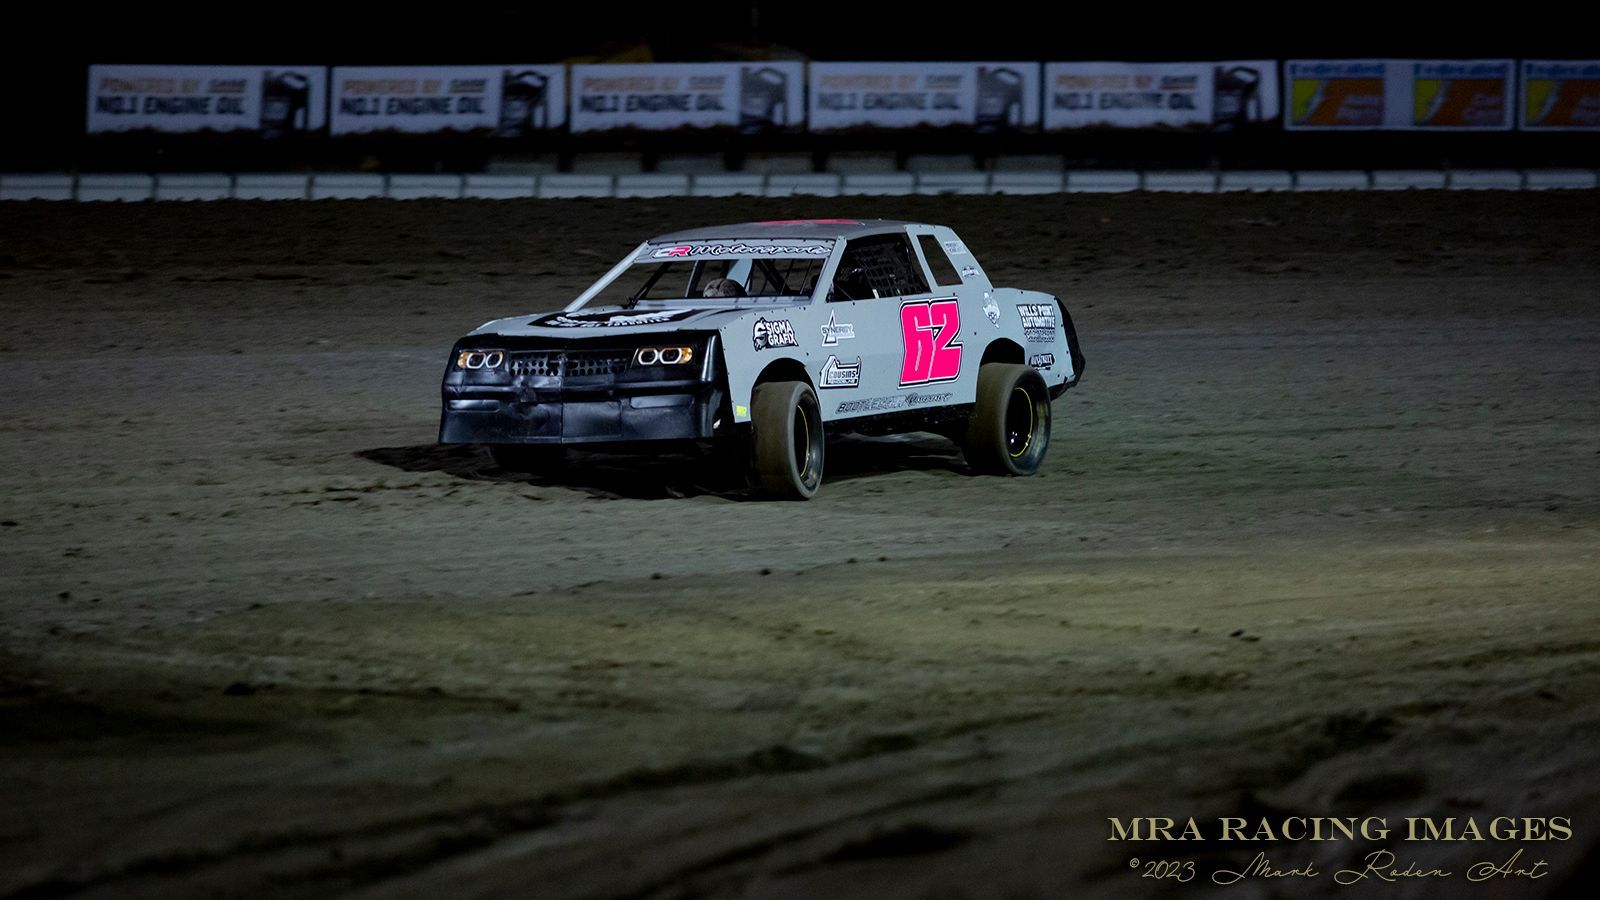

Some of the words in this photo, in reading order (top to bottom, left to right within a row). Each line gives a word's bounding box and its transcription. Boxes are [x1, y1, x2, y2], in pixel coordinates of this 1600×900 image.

[143, 95, 210, 114] ENGINE
[216, 95, 245, 114] OIL
[386, 97, 452, 115] ENGINE
[457, 97, 485, 115] OIL
[625, 94, 691, 112] ENGINE
[696, 94, 725, 111] OIL
[863, 93, 929, 110] ENGINE
[932, 93, 961, 109] OIL
[1099, 92, 1163, 109] ENGINE
[1168, 92, 1196, 109] OIL
[690, 243, 832, 257] Motorsports
[1017, 305, 1038, 316] WILLS
[766, 320, 793, 335] SIGMA
[1022, 316, 1056, 328] AUTOMOTIVE
[768, 333, 798, 347] GRAFIX
[898, 297, 963, 389] 62
[828, 370, 857, 379] COUSINS
